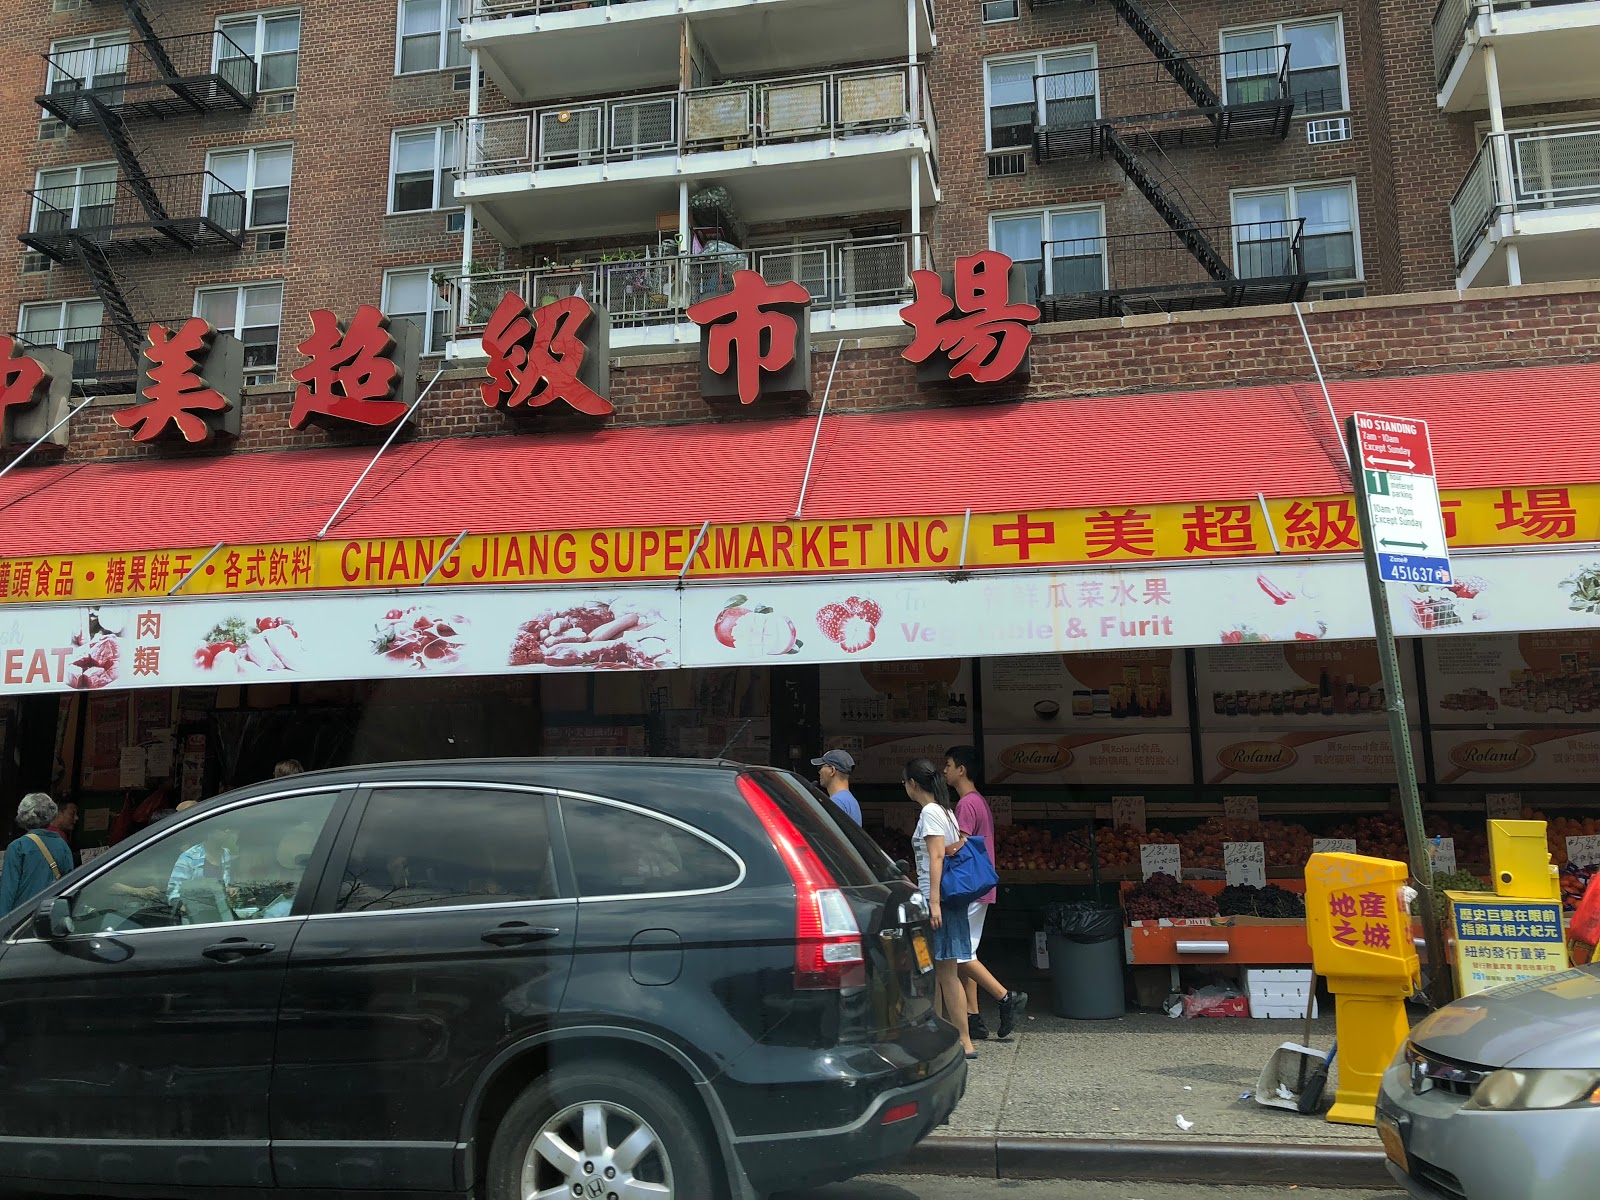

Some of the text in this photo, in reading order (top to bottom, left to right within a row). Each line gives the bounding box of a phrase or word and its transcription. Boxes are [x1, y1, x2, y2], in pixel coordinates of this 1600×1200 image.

[1359, 418, 1417, 435] NO STANDING
[1362, 431, 1377, 440] 7am
[1382, 434, 1399, 443] 10am
[1363, 441, 1411, 457] Except Sunday
[1390, 482, 1414, 490] metered
[1392, 491, 1413, 499] parking
[1373, 504, 1391, 513] 10am
[1396, 506, 1414, 516] 10pm
[1375, 515, 1422, 528] Except Sunday
[341, 520, 948, 583] CHANG JIANG SUPERMARKET INC
[1391, 564, 1433, 582] 451637
[900, 615, 1174, 643] Veble & Furit
[1010, 749, 1061, 765] Roland
[1231, 749, 1283, 764] Roland
[1462, 747, 1519, 762] Roland
[1329, 891, 1387, 918] 地產
[1460, 908, 1556, 922] 歷史巨變在眼前
[1333, 919, 1391, 949] 之城
[1461, 924, 1558, 938] 指路真相大紀元
[1464, 945, 1560, 960] 紐約發行量第一
